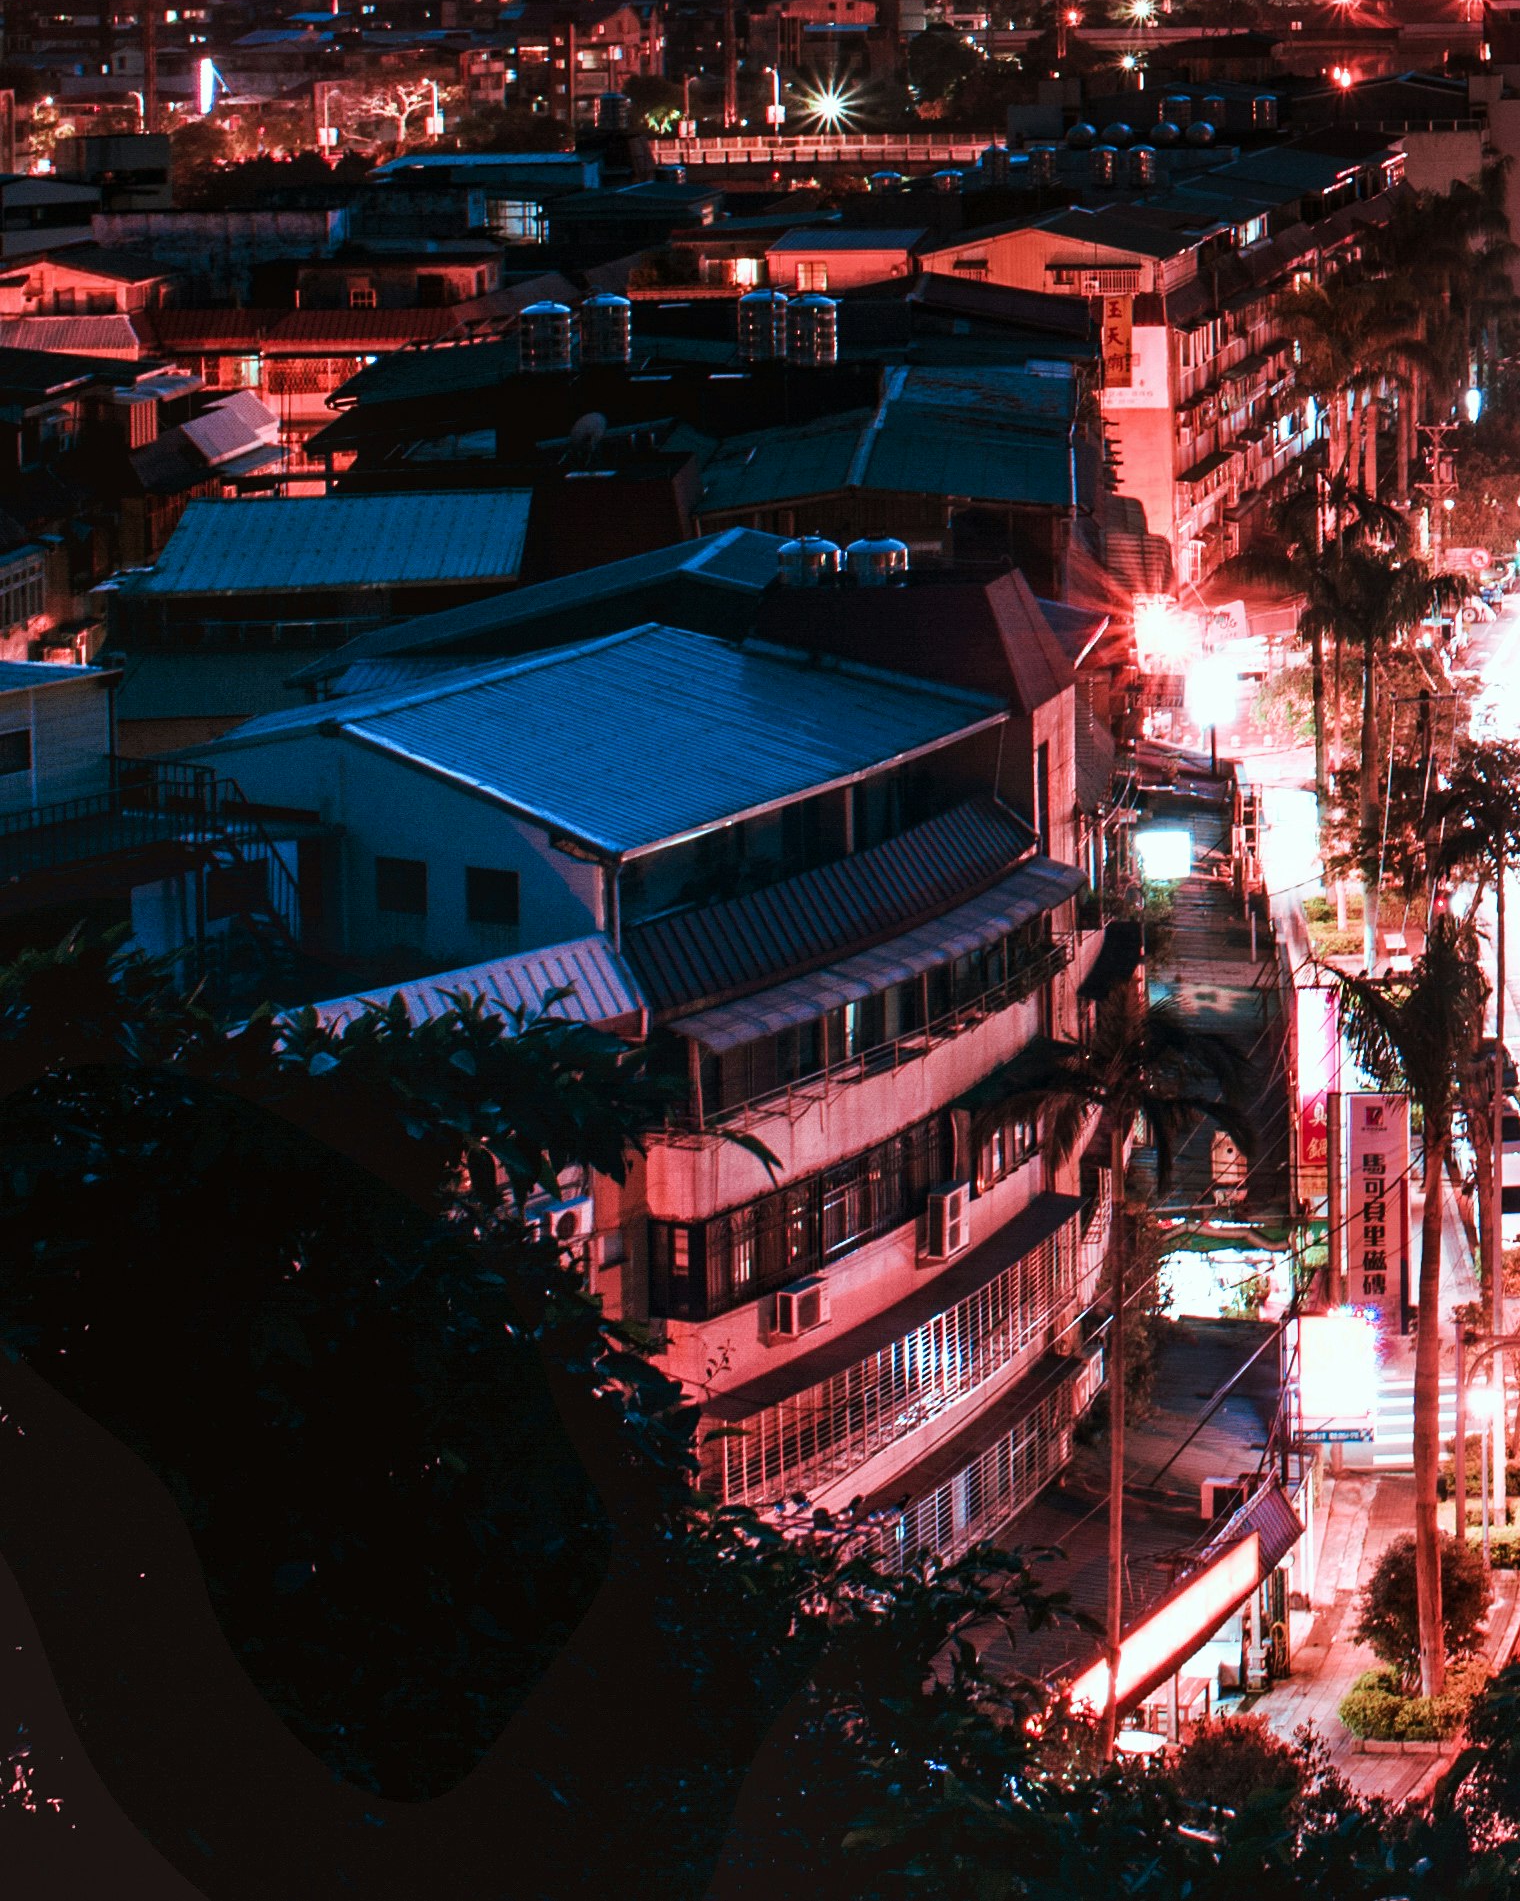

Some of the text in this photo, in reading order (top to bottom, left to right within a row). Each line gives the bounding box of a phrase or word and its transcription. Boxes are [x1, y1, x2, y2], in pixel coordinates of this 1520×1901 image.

[1362, 1153, 1386, 1295] 馬可貝里磁磚
